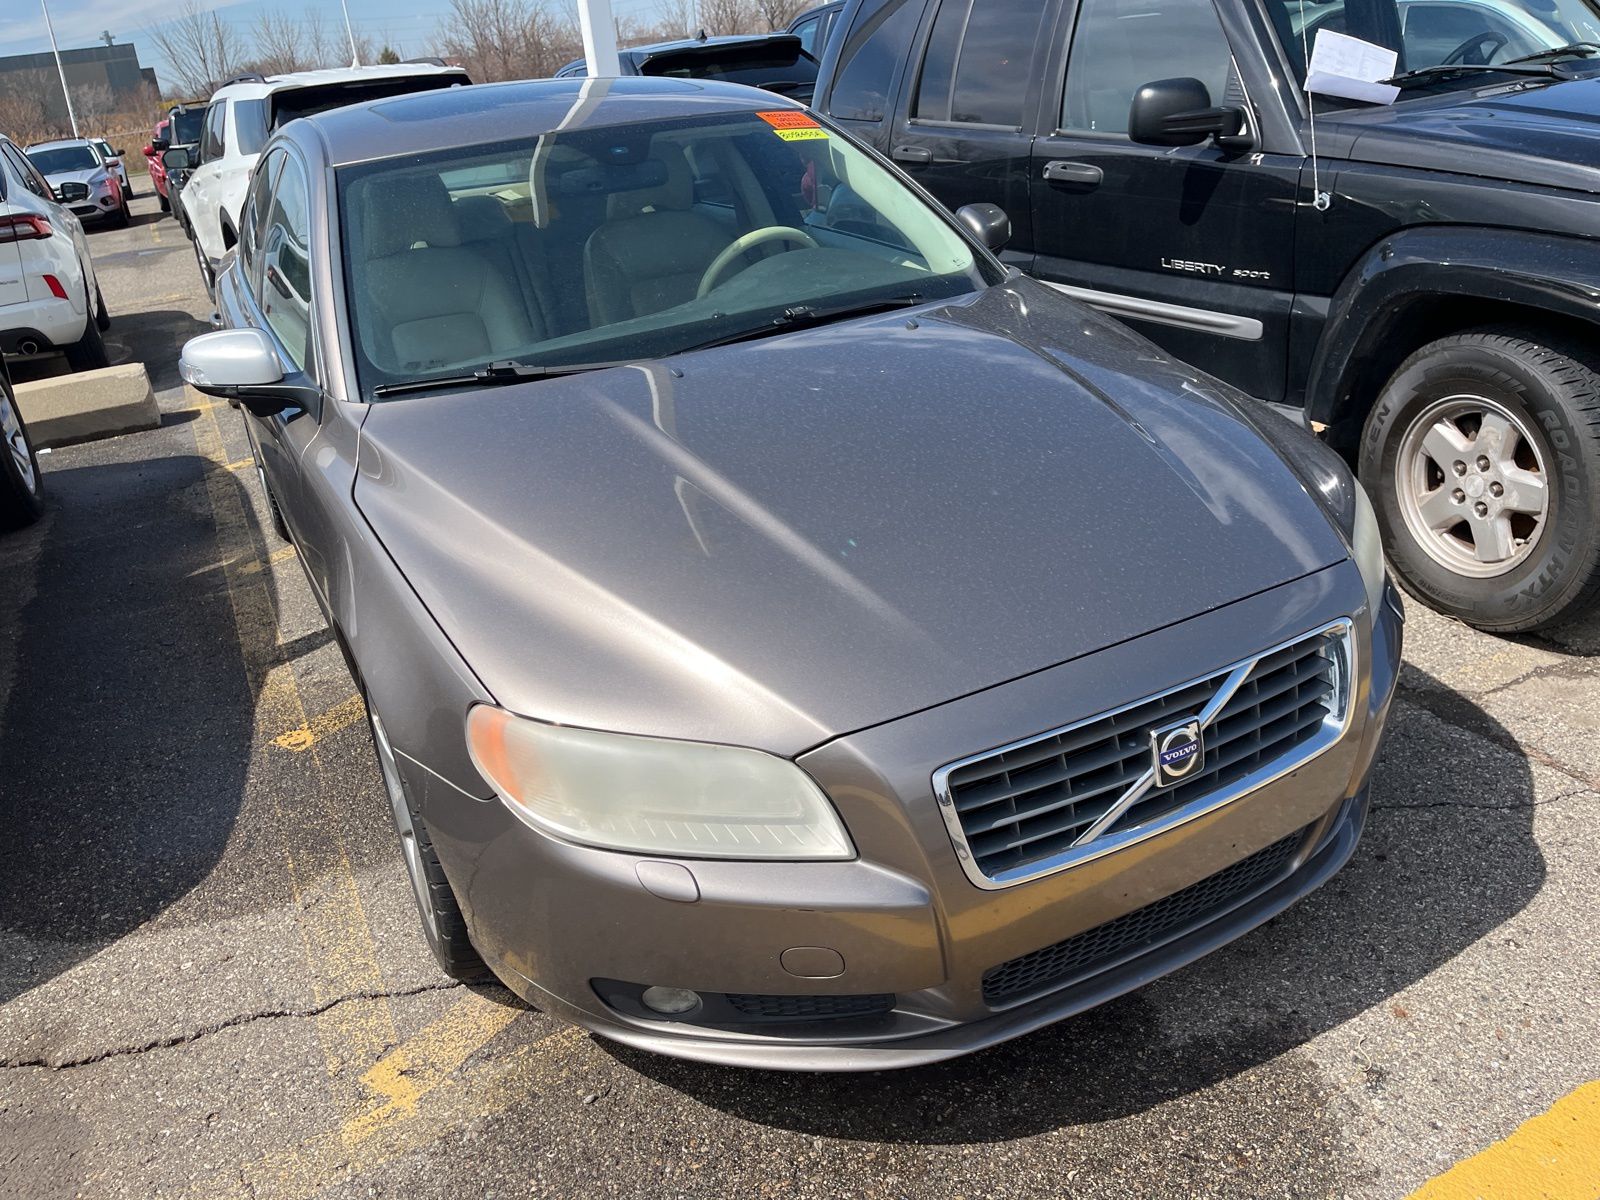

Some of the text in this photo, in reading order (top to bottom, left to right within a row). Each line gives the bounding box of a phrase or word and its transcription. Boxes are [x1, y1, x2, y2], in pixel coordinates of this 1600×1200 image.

[1161, 257, 1271, 280] LIBERTY sport
[1163, 743, 1198, 761] VOLVO
